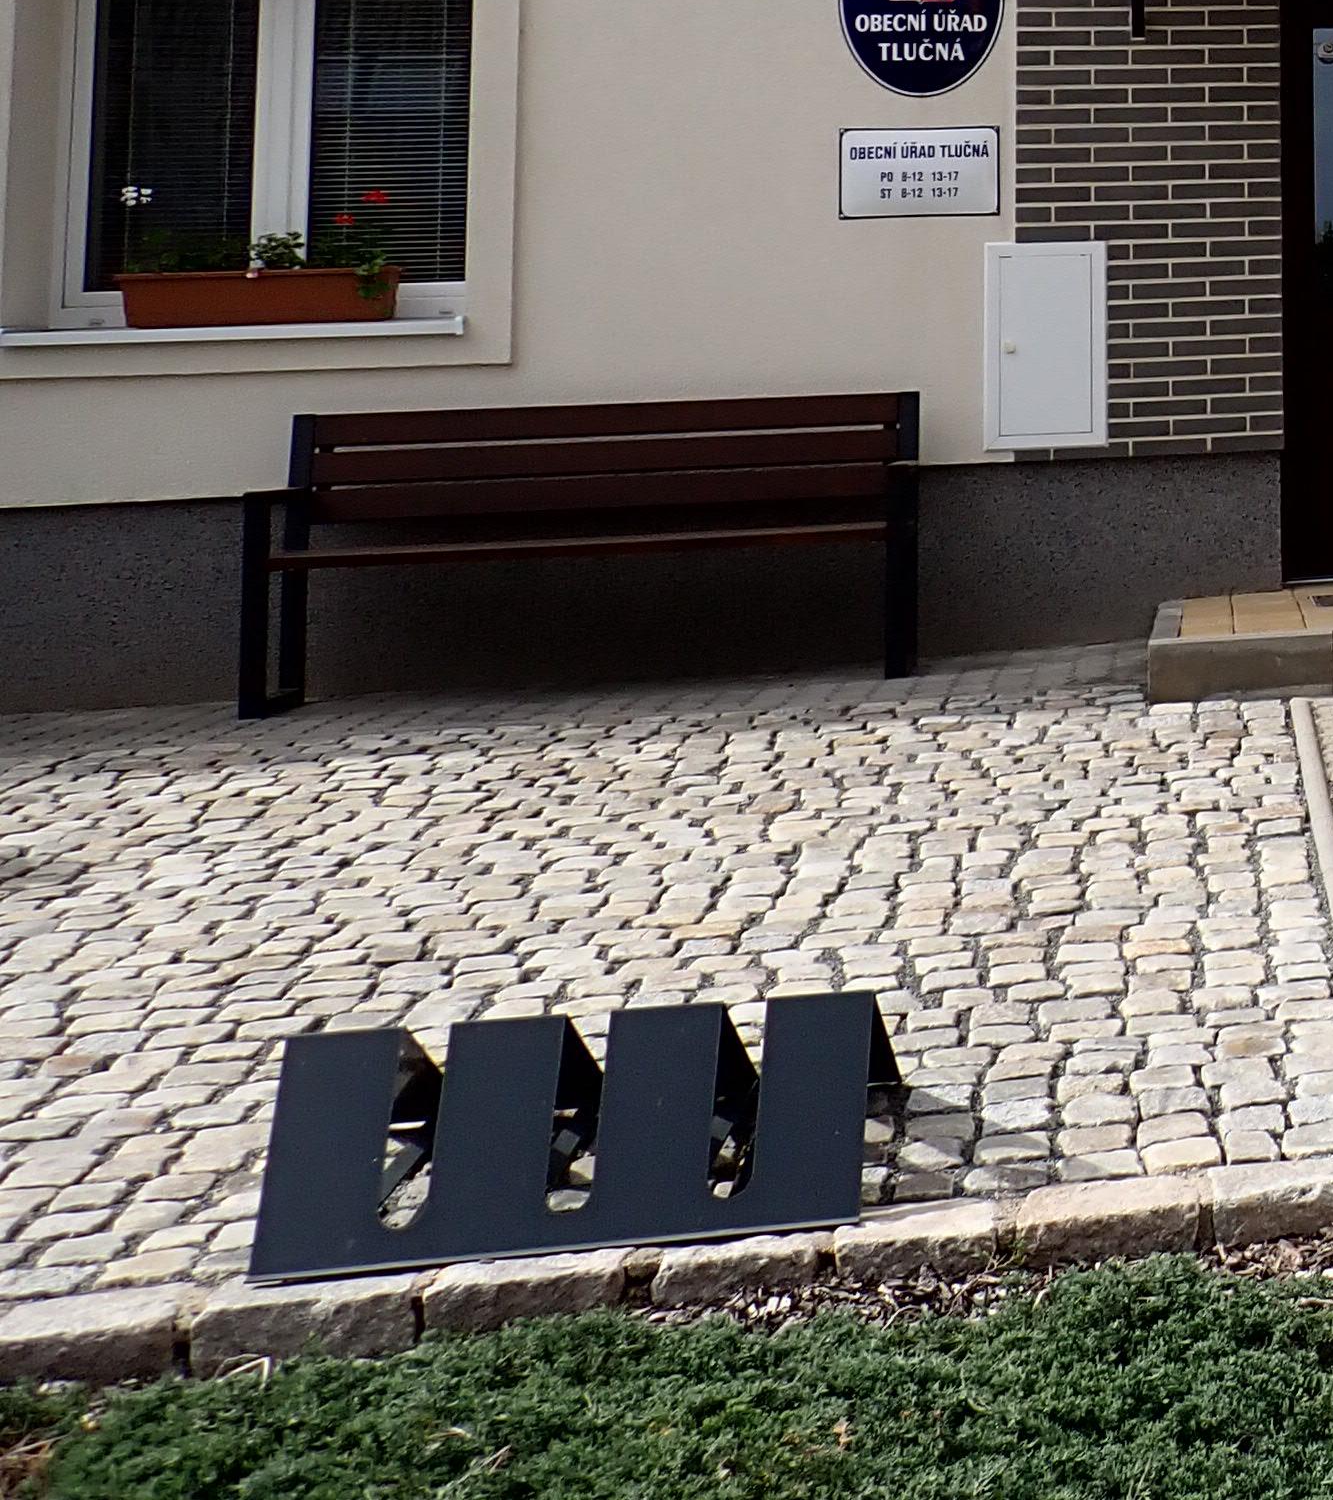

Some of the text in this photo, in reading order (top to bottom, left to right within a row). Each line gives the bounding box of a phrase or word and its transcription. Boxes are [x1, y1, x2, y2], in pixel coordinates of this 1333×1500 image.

[854, 9, 988, 32] OBECNÍ ÚŘAD
[878, 38, 965, 61] TLUČNÁ
[849, 140, 989, 160] OBECNÍ ÚŘAD TLUČNÁ
[880, 171, 894, 182] PO
[931, 171, 959, 182] 13-17
[880, 187, 892, 199] ST
[931, 187, 959, 198] 13-17
